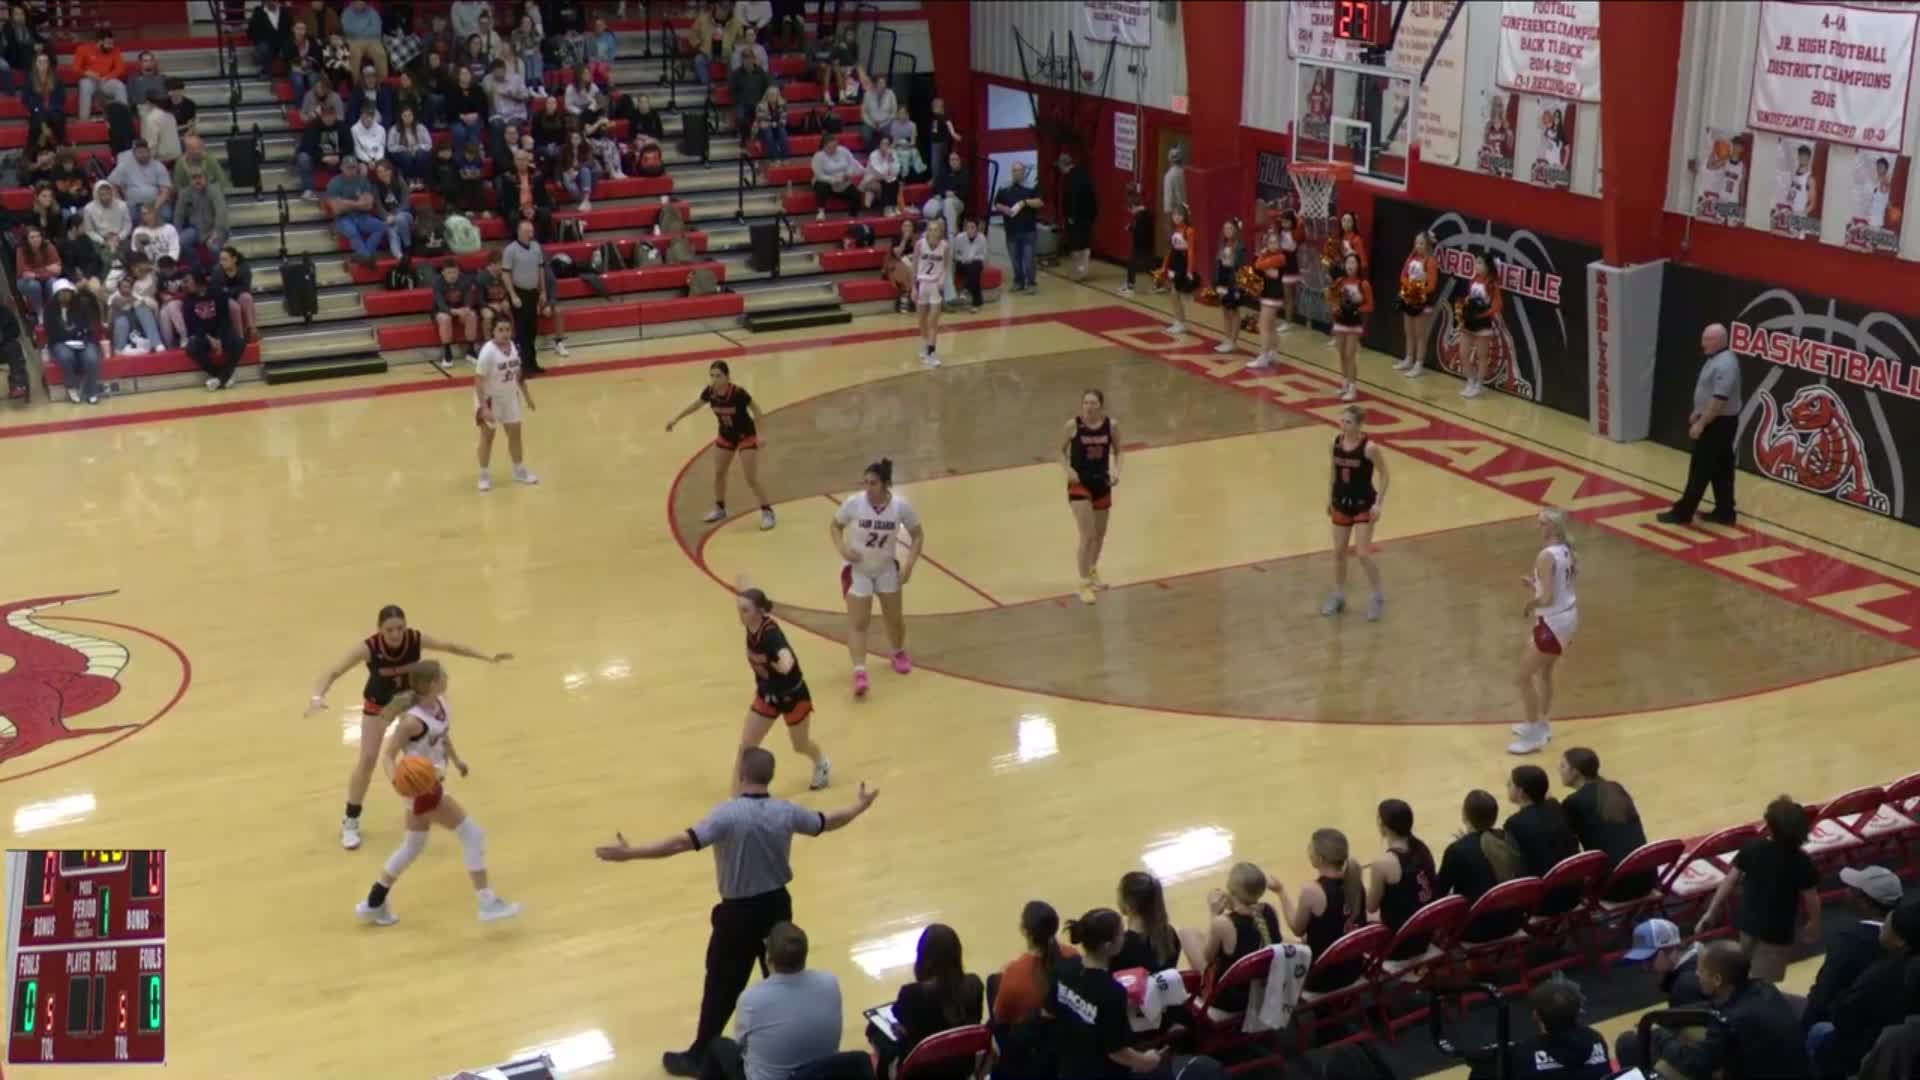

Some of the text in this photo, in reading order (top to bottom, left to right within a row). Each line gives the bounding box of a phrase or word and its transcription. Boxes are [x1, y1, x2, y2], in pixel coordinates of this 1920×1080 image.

[1340, 3, 1369, 38] 27
[1520, 37, 1545, 52] BACK
[1559, 42, 1585, 58] BACK
[1776, 37, 1887, 63] JR. HIGH FOOTBALL
[1767, 59, 1892, 90] DISTRICT CHAMPIONS
[1817, 118, 1857, 138] RECORD
[1729, 321, 1920, 400] BASKETBALL
